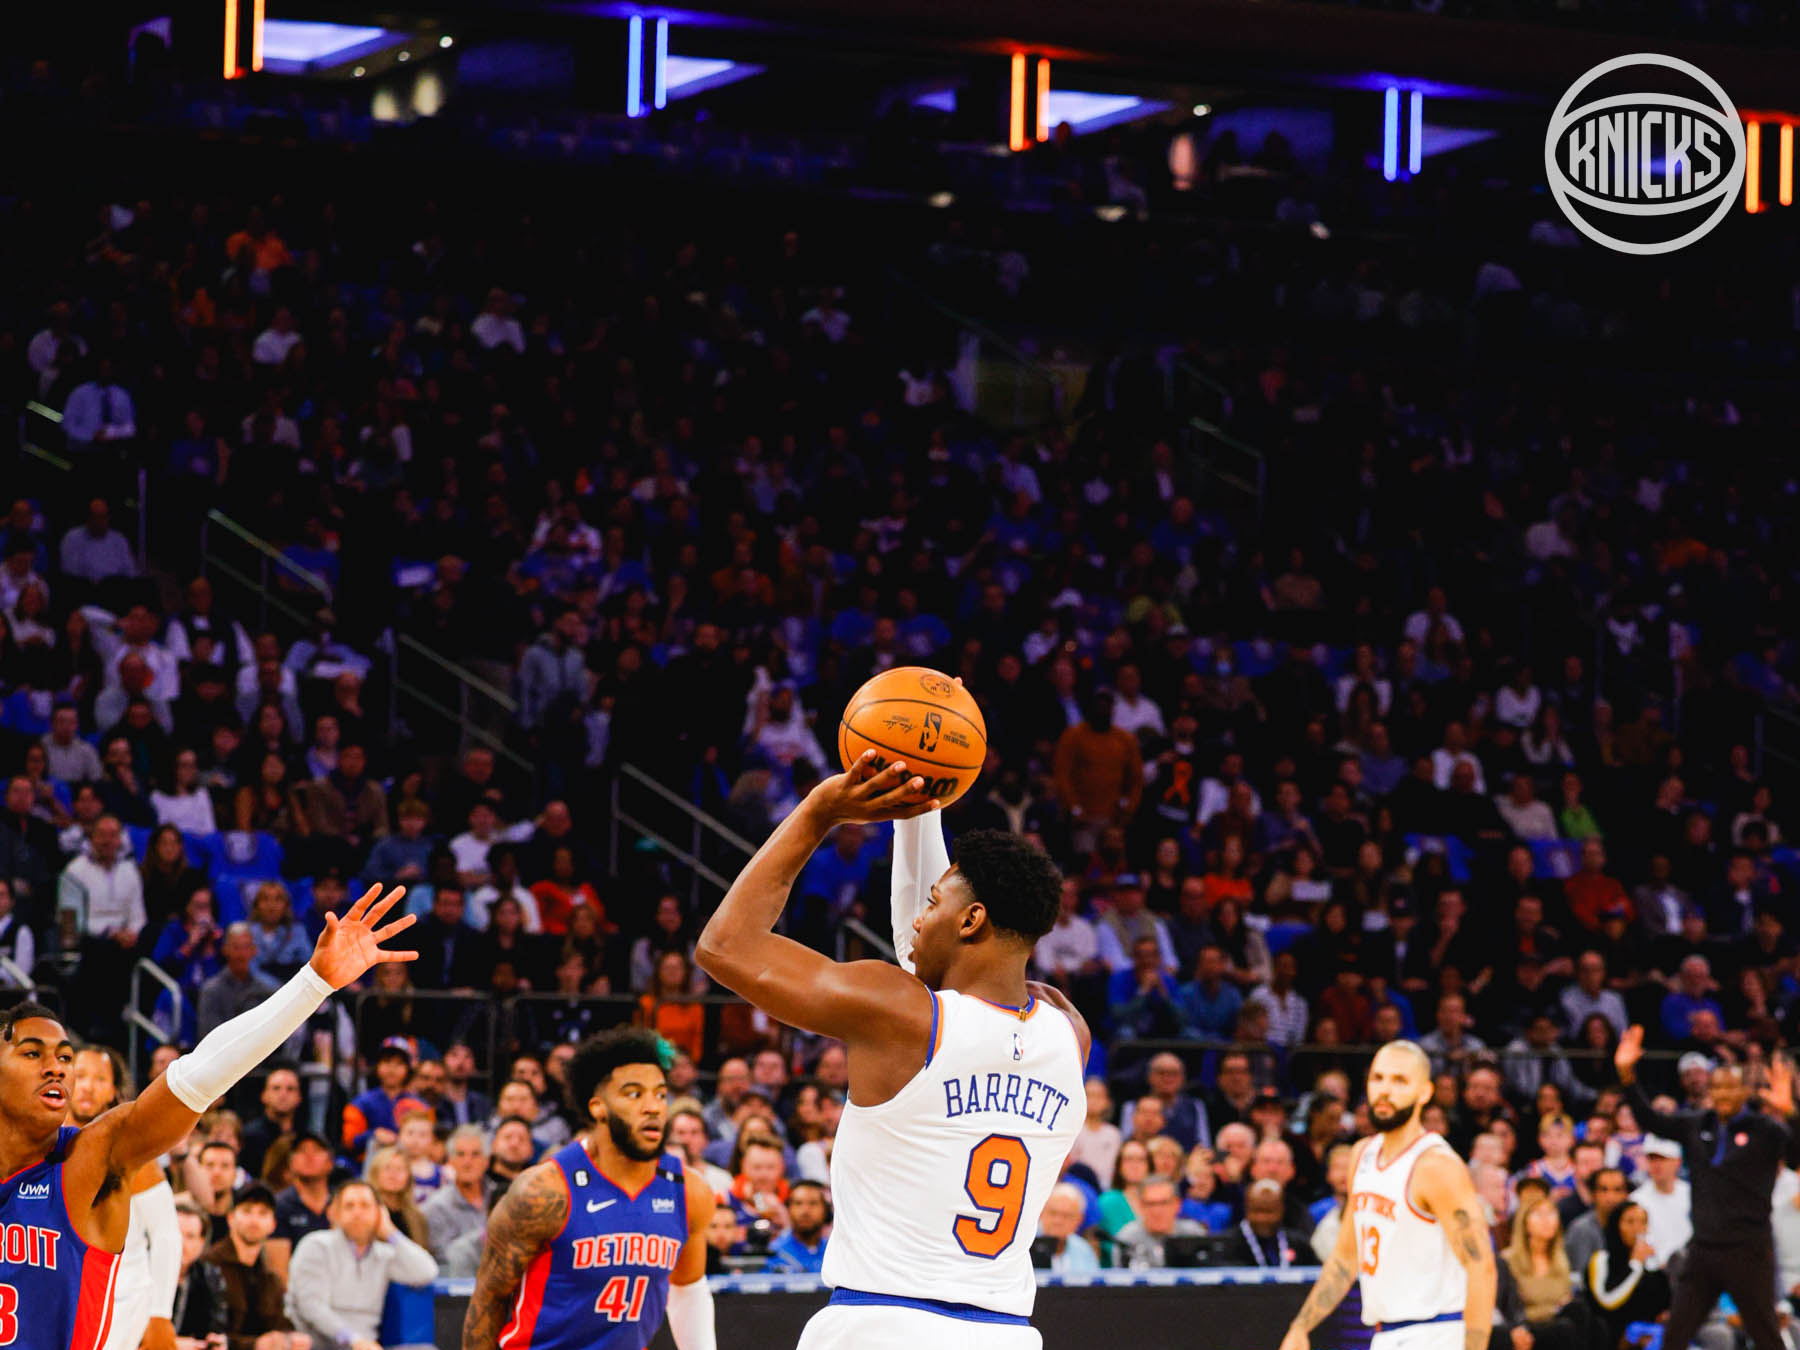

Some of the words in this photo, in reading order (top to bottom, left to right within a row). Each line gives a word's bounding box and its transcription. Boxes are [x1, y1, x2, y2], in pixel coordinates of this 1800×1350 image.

[943, 1073, 1070, 1131] BARRETT
[18, 1182, 50, 1195] UWM
[952, 1133, 1031, 1260] 9
[0, 1222, 61, 1270] OIT
[572, 1233, 681, 1271] DETROIT
[595, 1276, 649, 1322] 41
